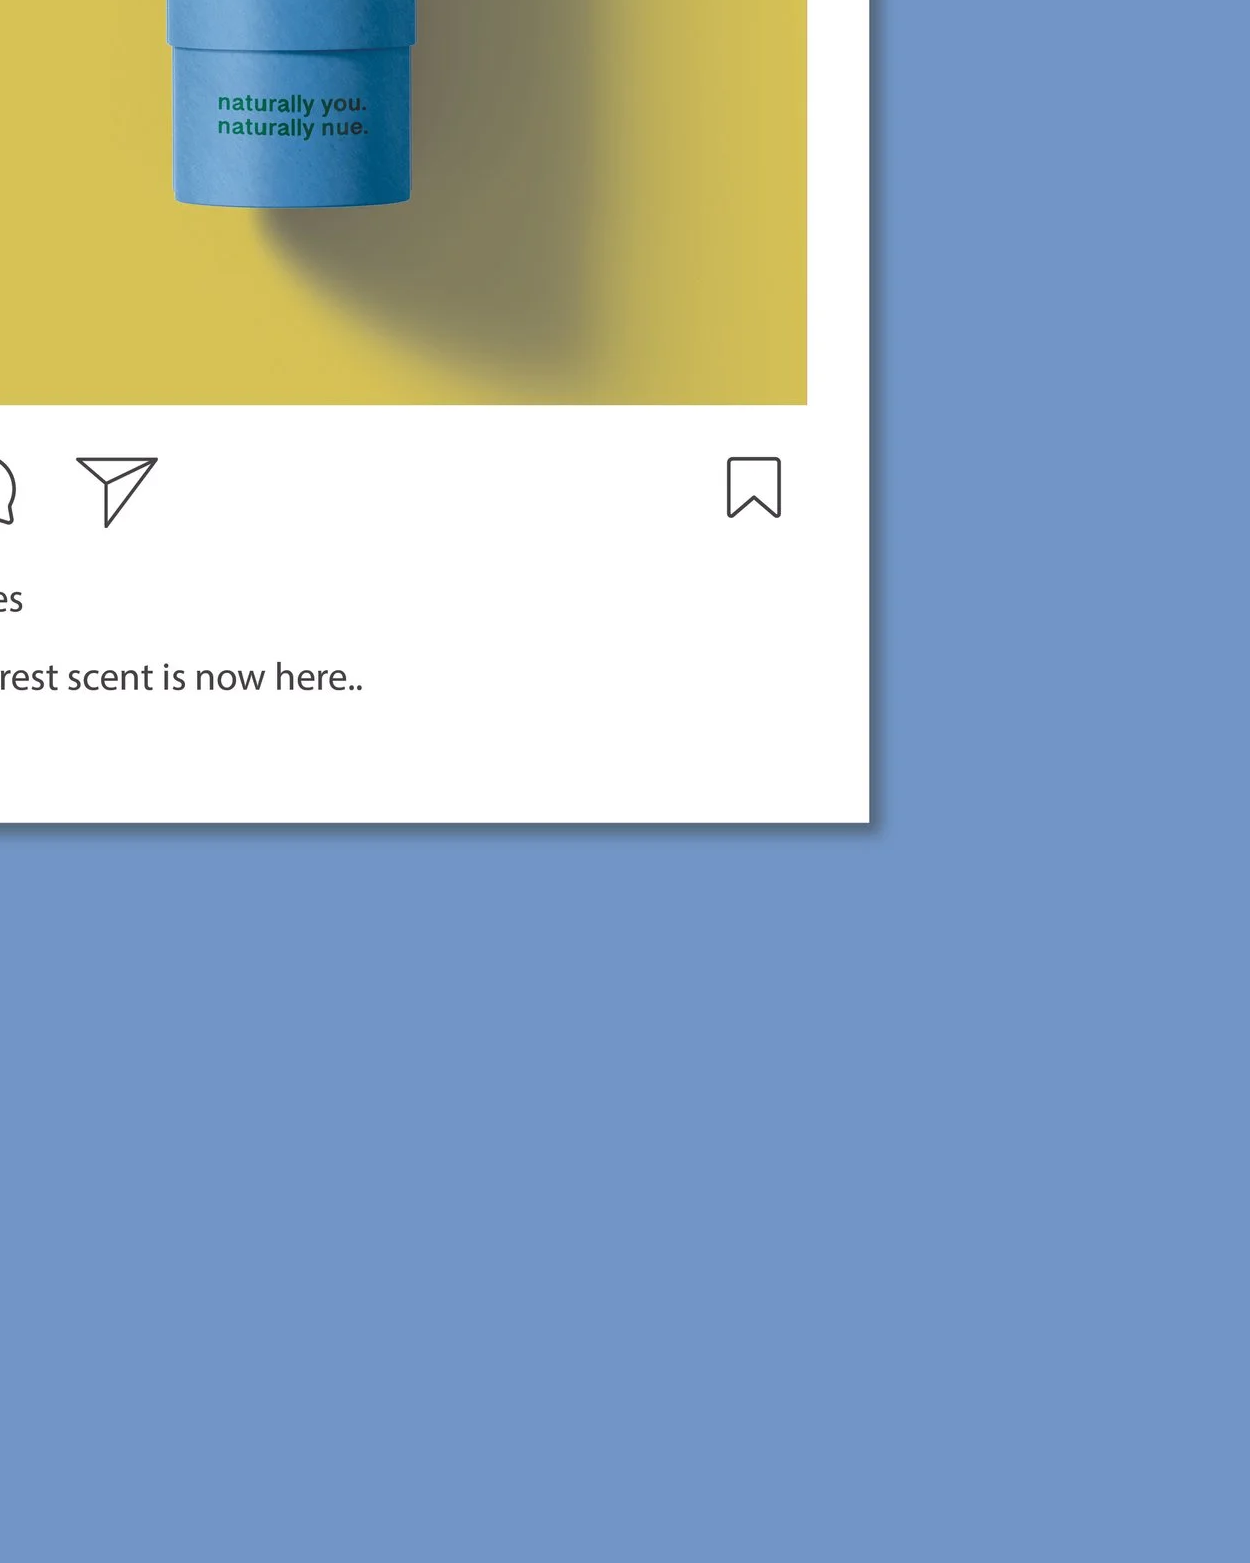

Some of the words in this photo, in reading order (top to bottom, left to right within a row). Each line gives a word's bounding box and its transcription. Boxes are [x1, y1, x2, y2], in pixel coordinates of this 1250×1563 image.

[218, 94, 314, 118] naturally
[321, 97, 367, 118] you.
[218, 118, 315, 141] naturally
[322, 120, 369, 136] nue.
[67, 664, 154, 691] scent
[163, 662, 186, 691] is
[196, 669, 266, 691] now
[276, 661, 363, 691] here..
